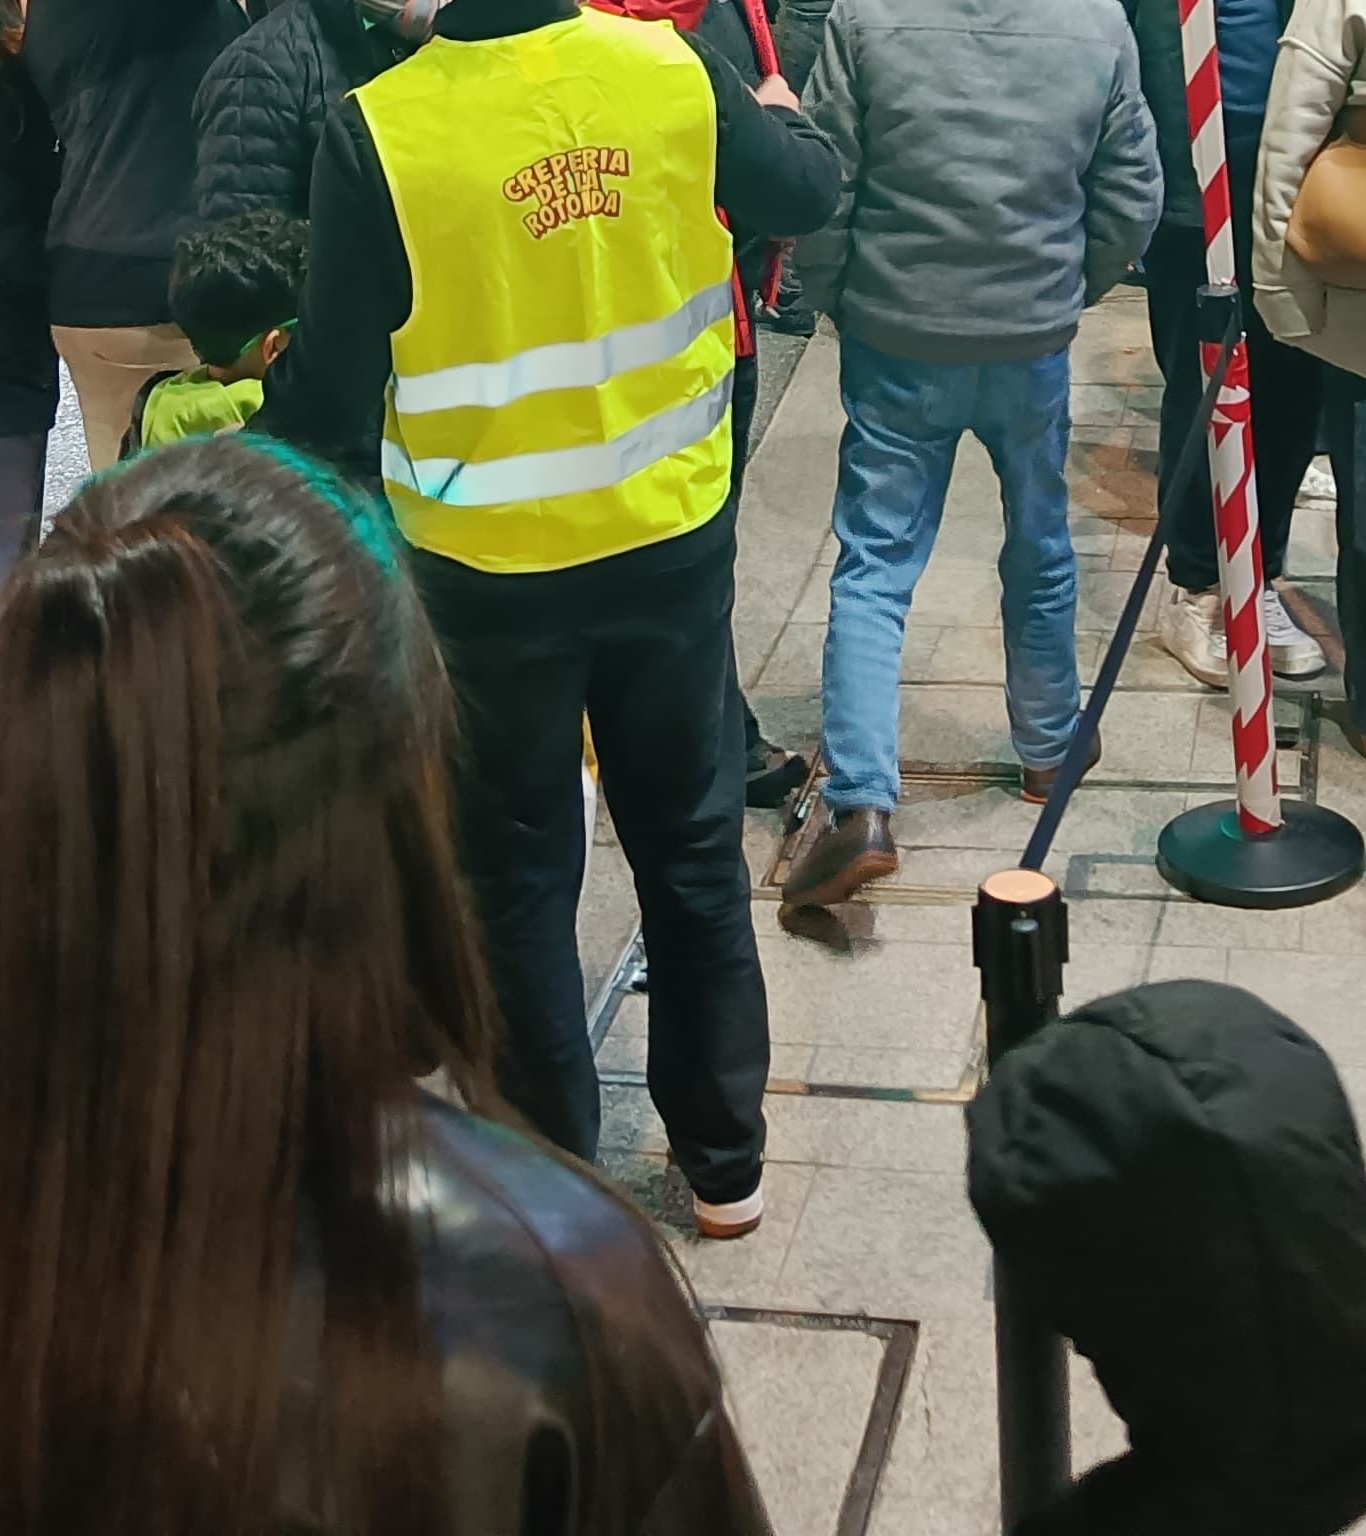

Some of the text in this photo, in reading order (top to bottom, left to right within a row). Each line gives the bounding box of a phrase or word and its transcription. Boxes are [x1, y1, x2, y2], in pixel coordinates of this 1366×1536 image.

[503, 146, 629, 202] CREPERIA
[535, 175, 568, 205] DE
[523, 190, 620, 240] ROTONDA
